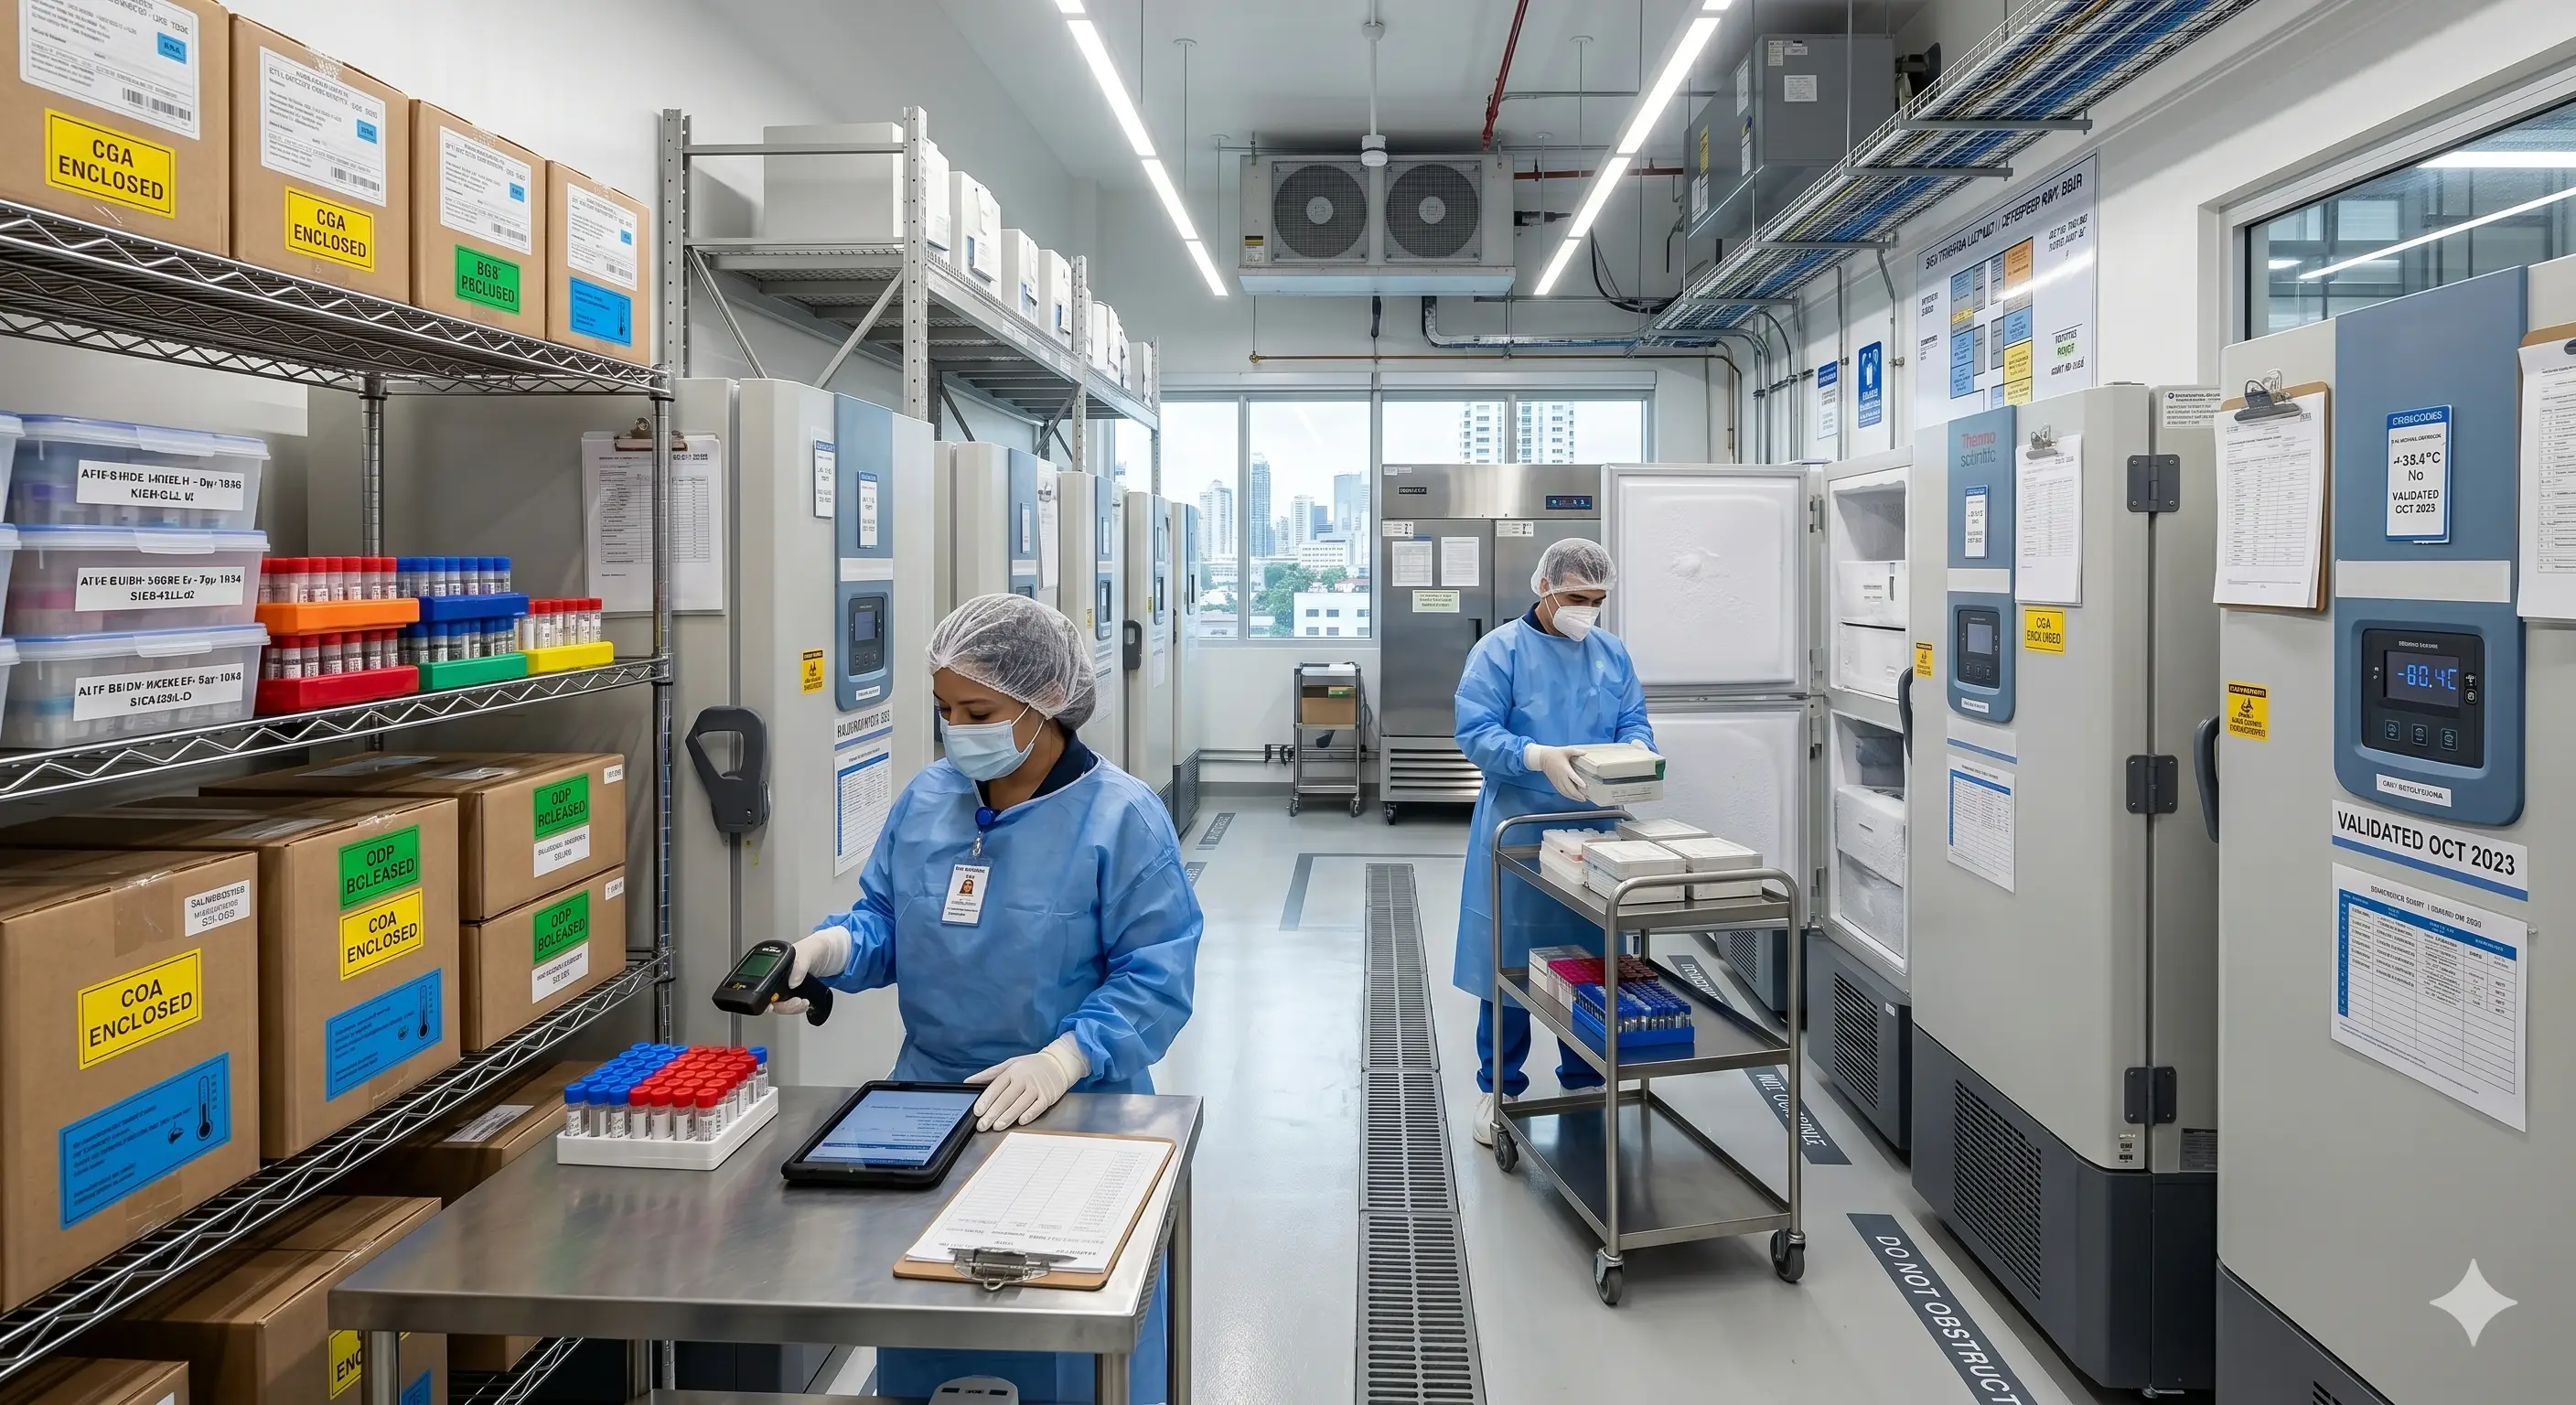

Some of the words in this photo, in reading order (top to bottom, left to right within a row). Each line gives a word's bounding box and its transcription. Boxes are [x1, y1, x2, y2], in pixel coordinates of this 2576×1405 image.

[92, 139, 134, 168] CGA
[59, 155, 164, 200] ENCLOSED
[317, 208, 346, 231] CGA
[294, 224, 367, 258] ENCLOSED
[2408, 469, 2424, 481] No
[2392, 489, 2440, 501] VALIDATED
[2416, 503, 2436, 513] 2023
[552, 788, 572, 806] ODP
[366, 844, 395, 868] ODP
[2337, 810, 2423, 851] VALIDATED
[2429, 834, 2466, 863] OCT
[2471, 845, 2517, 876] 2023
[369, 910, 397, 935] COA
[347, 923, 418, 964] ENCLOSED
[121, 979, 163, 1008] COA
[89, 992, 193, 1048] ENCLOSED
[1875, 1236, 1910, 1259] DO
[1894, 1261, 1941, 1298] NOT
[1925, 1302, 2023, 1405] OBSTRUCT
